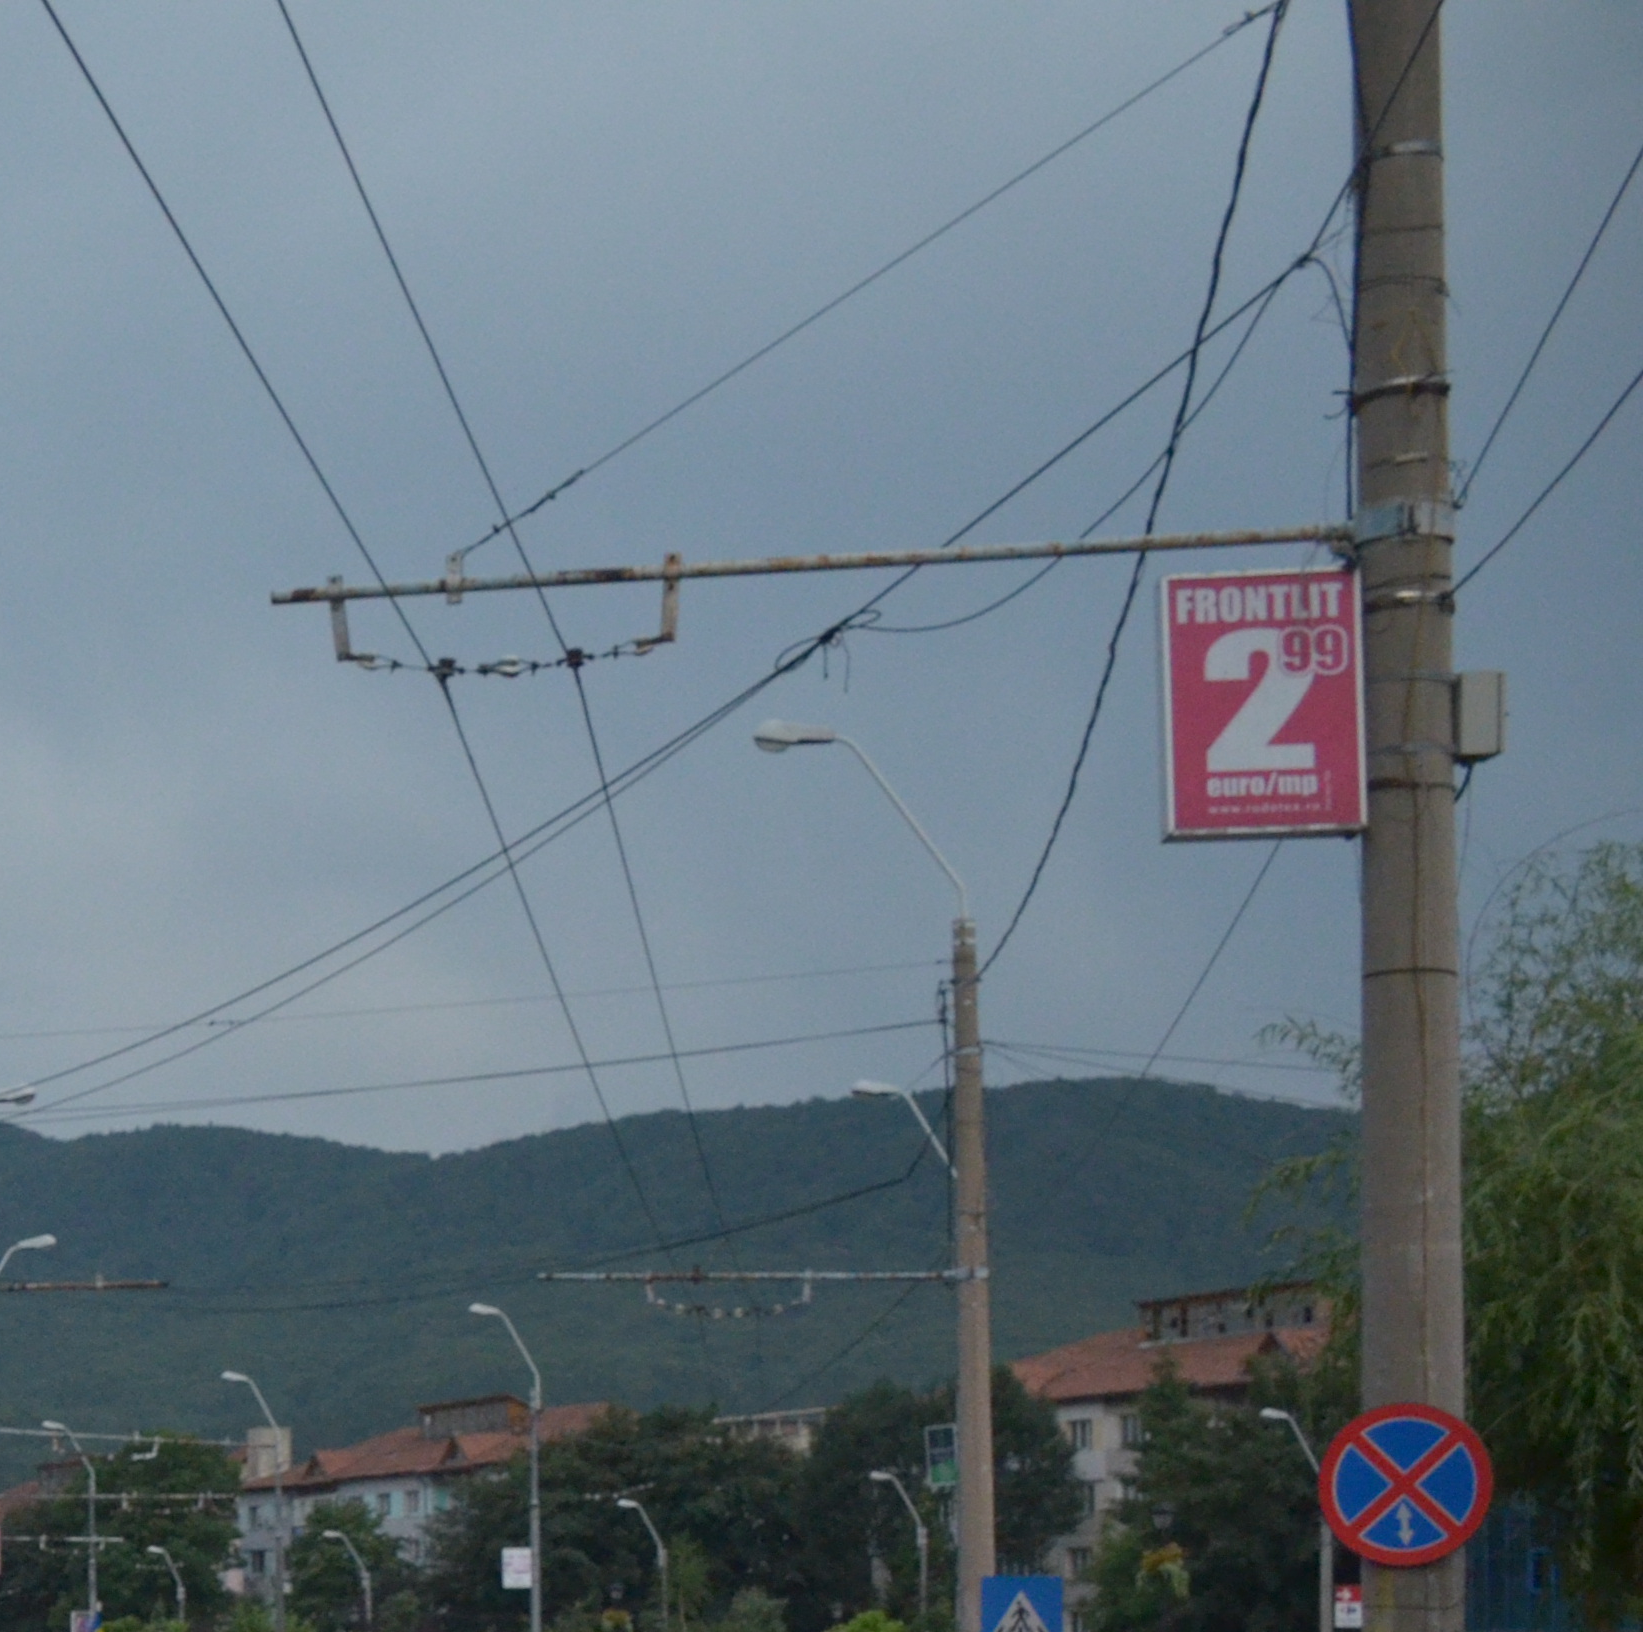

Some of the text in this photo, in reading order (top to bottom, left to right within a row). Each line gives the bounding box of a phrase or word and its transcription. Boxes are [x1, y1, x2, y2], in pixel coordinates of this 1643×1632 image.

[1176, 582, 1342, 624] FRONTLIT
[1204, 627, 1315, 773] 2
[1206, 771, 1318, 797] euro/mp
